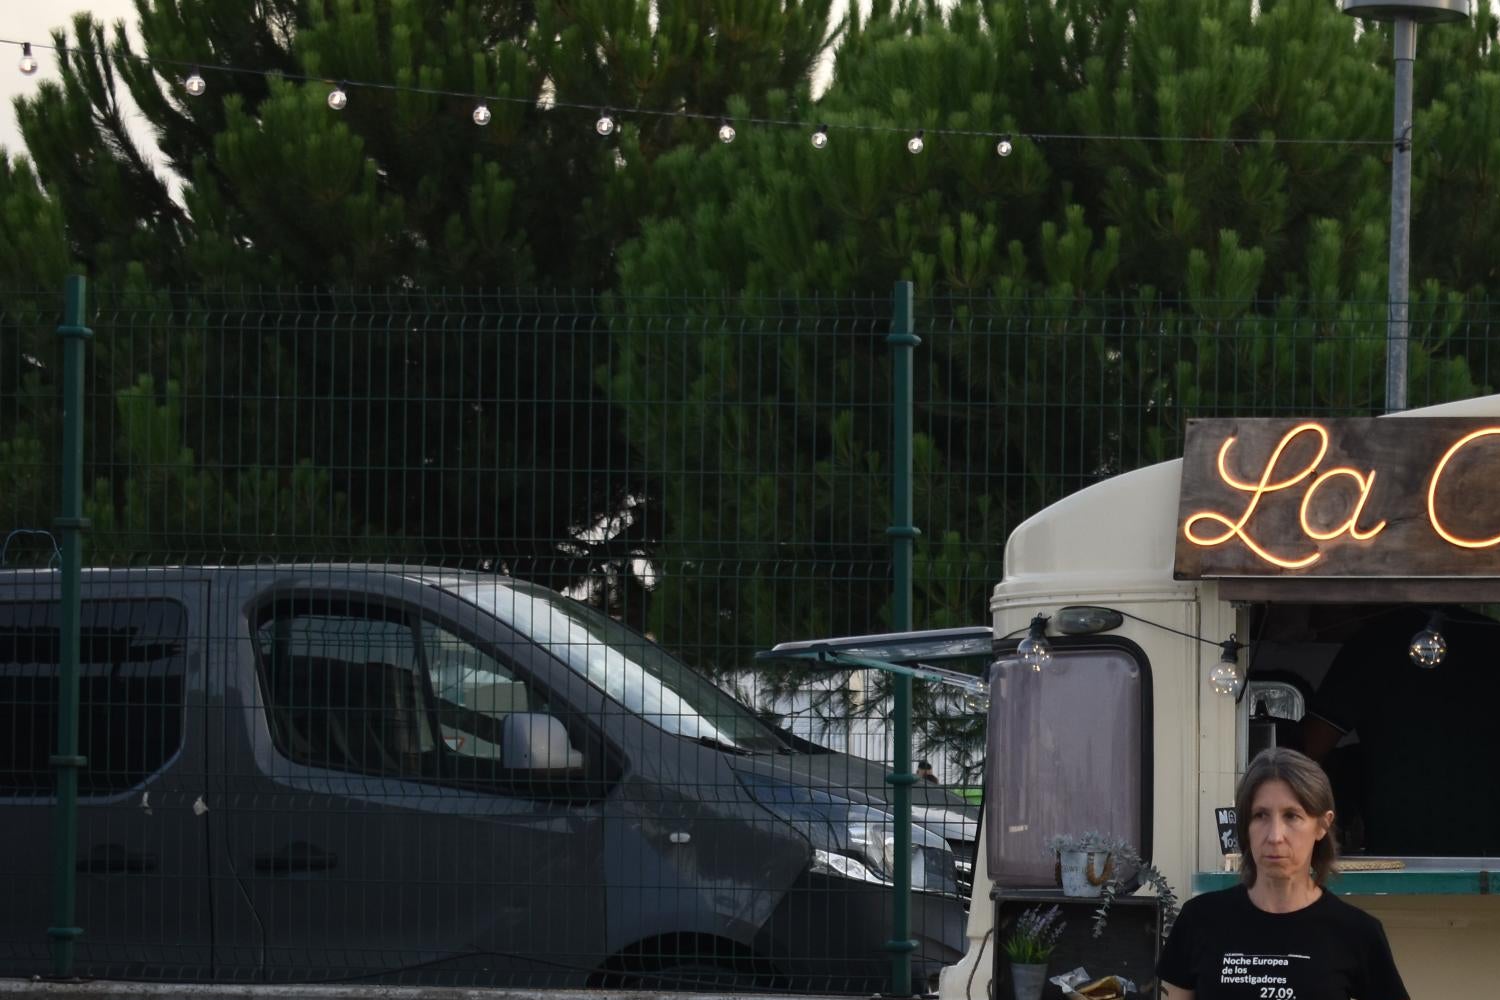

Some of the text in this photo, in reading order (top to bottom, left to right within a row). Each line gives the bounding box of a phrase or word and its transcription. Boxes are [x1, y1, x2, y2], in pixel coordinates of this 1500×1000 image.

[1183, 422, 1387, 569] La
[1223, 957, 1289, 967] Noche Europea
[1221, 965, 1248, 975] de los
[1220, 974, 1287, 985] Investigadores
[1260, 987, 1297, 1000] 27.09.
